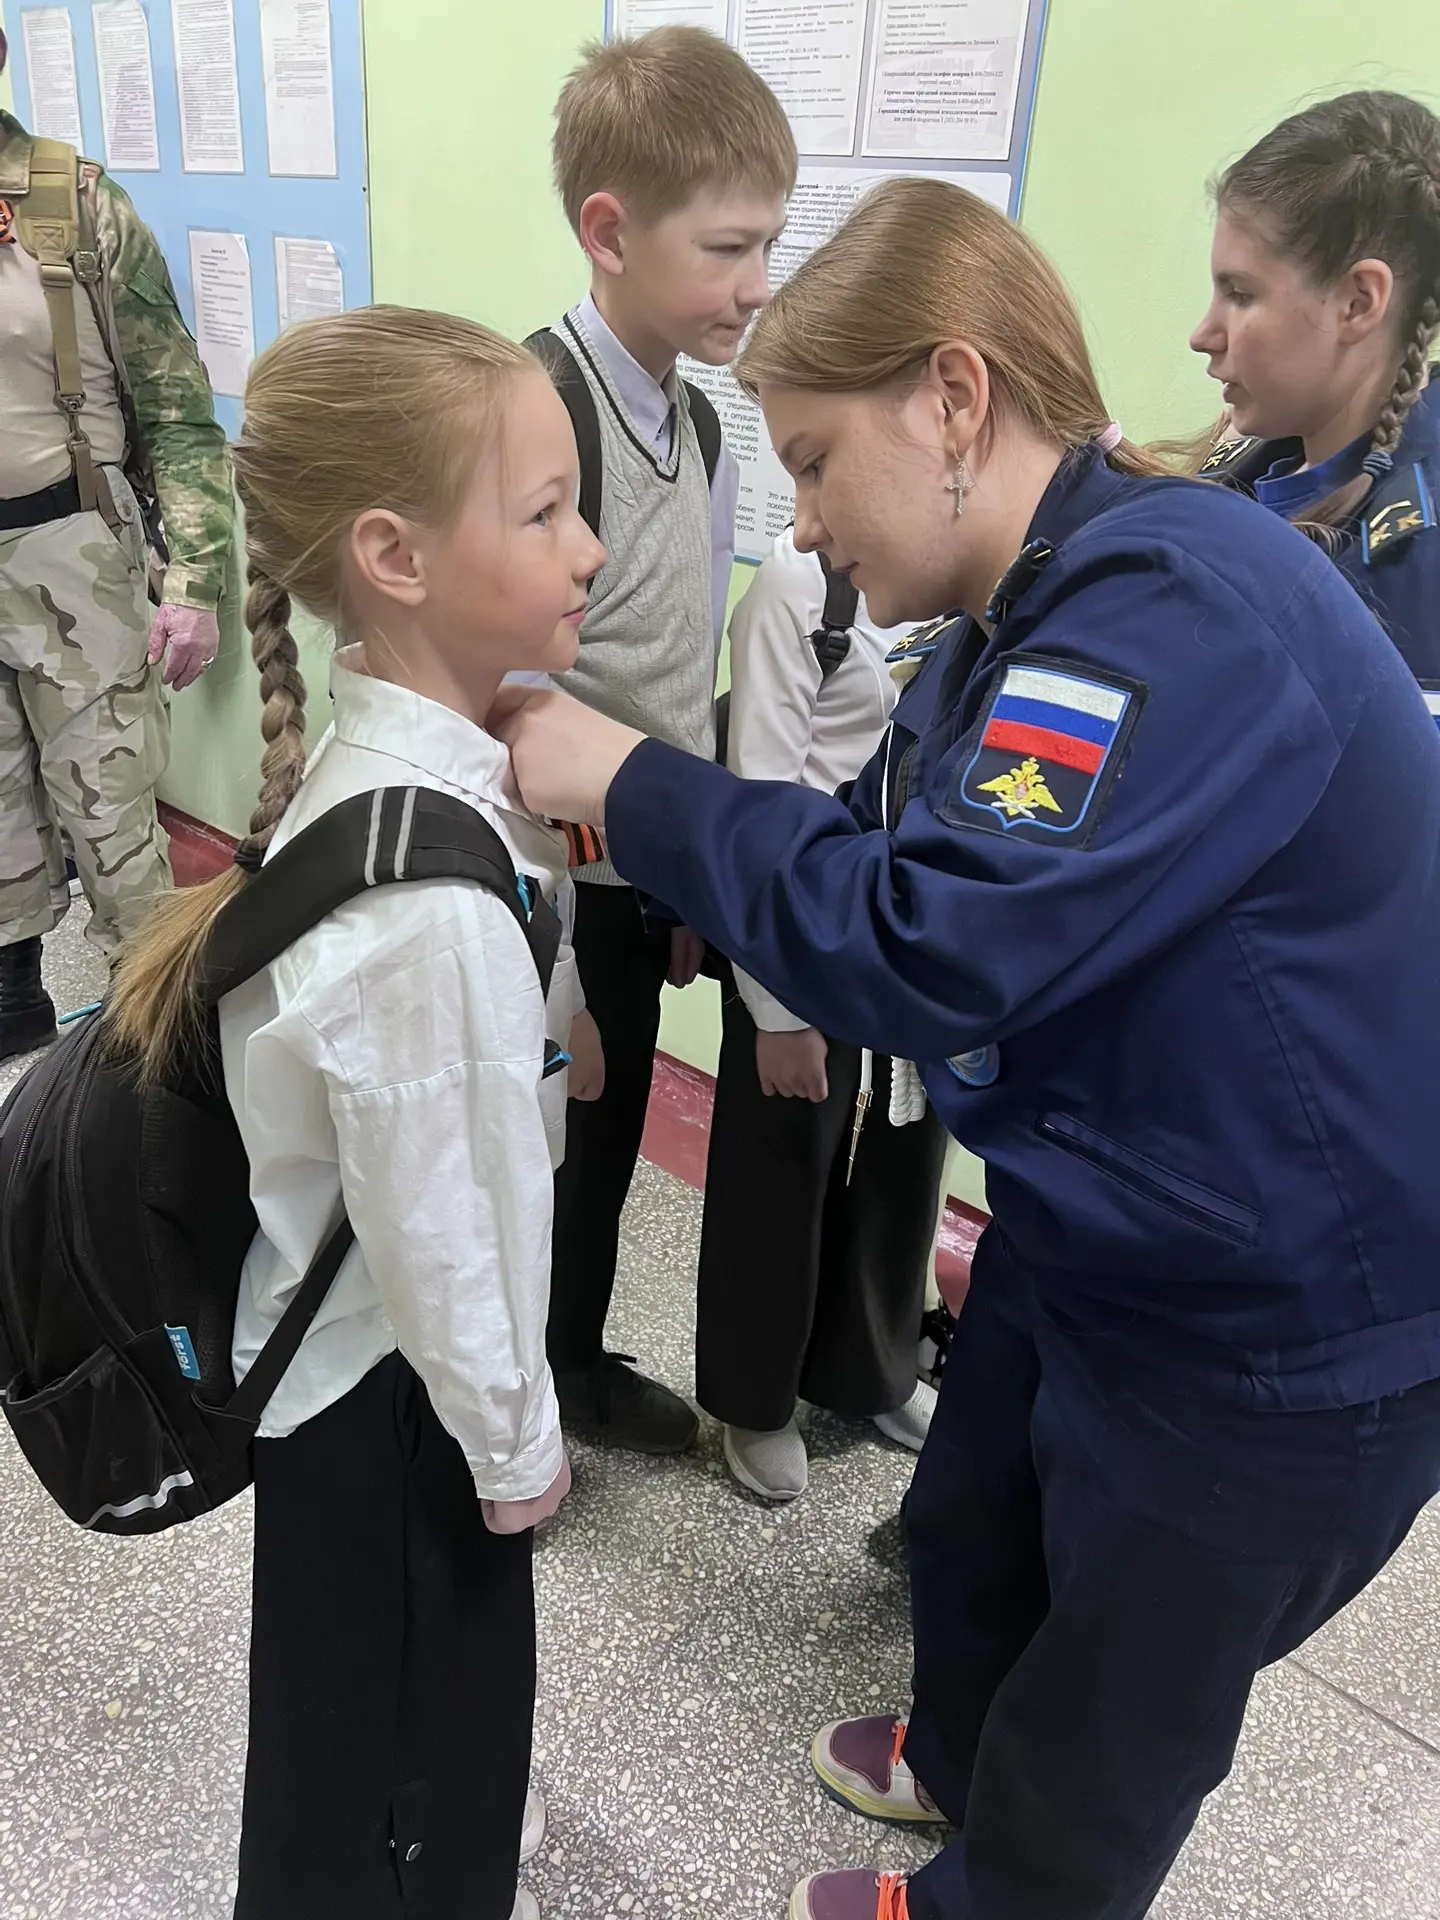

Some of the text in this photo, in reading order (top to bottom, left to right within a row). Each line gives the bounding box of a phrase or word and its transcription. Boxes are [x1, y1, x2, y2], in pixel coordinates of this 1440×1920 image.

[727, 432, 759, 443] отношения
[740, 443, 759, 454] выбор
[740, 485, 753, 493] этом
[767, 490, 779, 500] Это
[780, 494, 789, 502] же
